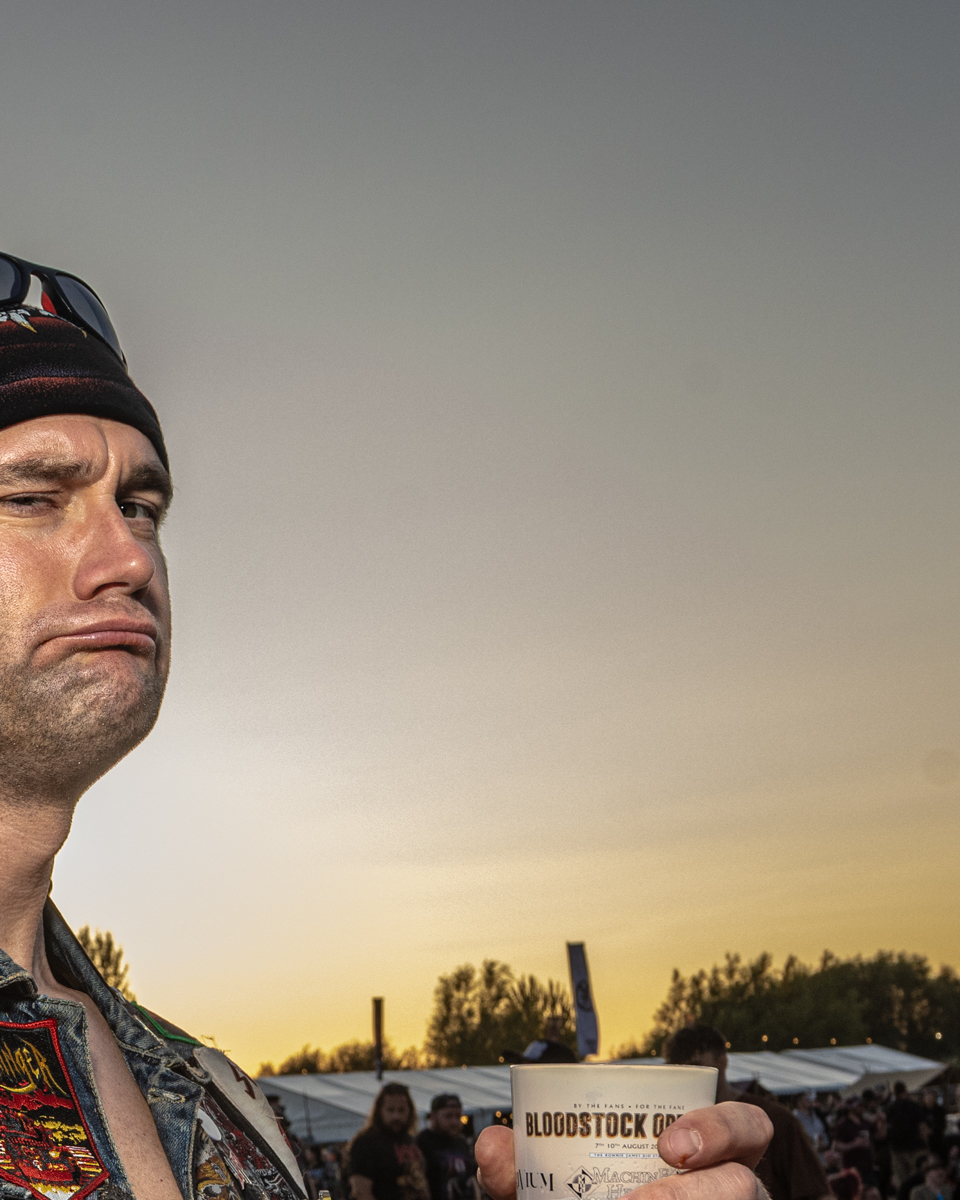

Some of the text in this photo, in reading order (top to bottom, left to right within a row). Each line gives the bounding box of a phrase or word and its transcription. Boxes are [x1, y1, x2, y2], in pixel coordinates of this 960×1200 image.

[525, 1111, 684, 1138] BLOODSTOCK OP
[592, 1166, 669, 1184] MACHINE
[607, 1184, 632, 1199] HE
